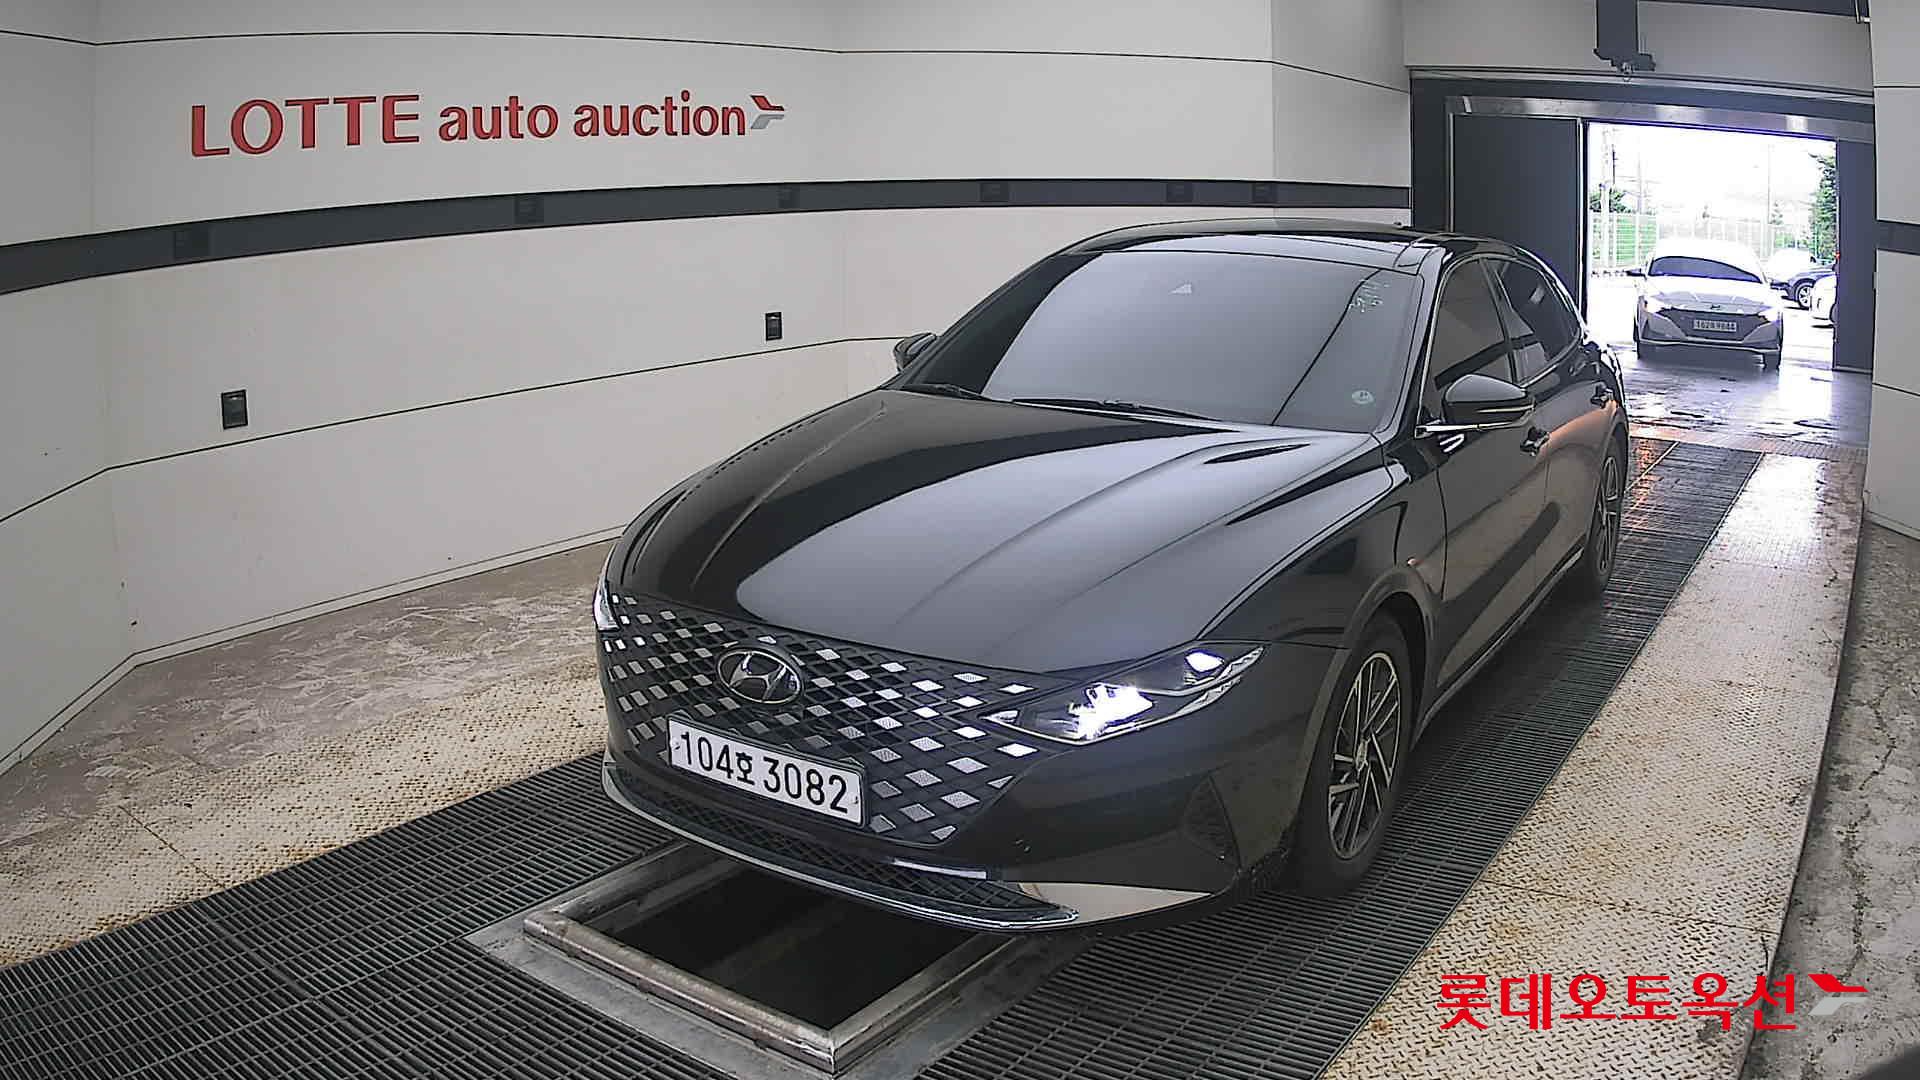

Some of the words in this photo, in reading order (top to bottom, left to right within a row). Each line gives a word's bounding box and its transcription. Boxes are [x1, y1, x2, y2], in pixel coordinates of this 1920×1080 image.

[191, 94, 419, 157] LOTTE
[438, 95, 559, 142] auto
[574, 90, 747, 138] auction
[680, 731, 755, 786] 104호
[763, 756, 848, 814] 3082
